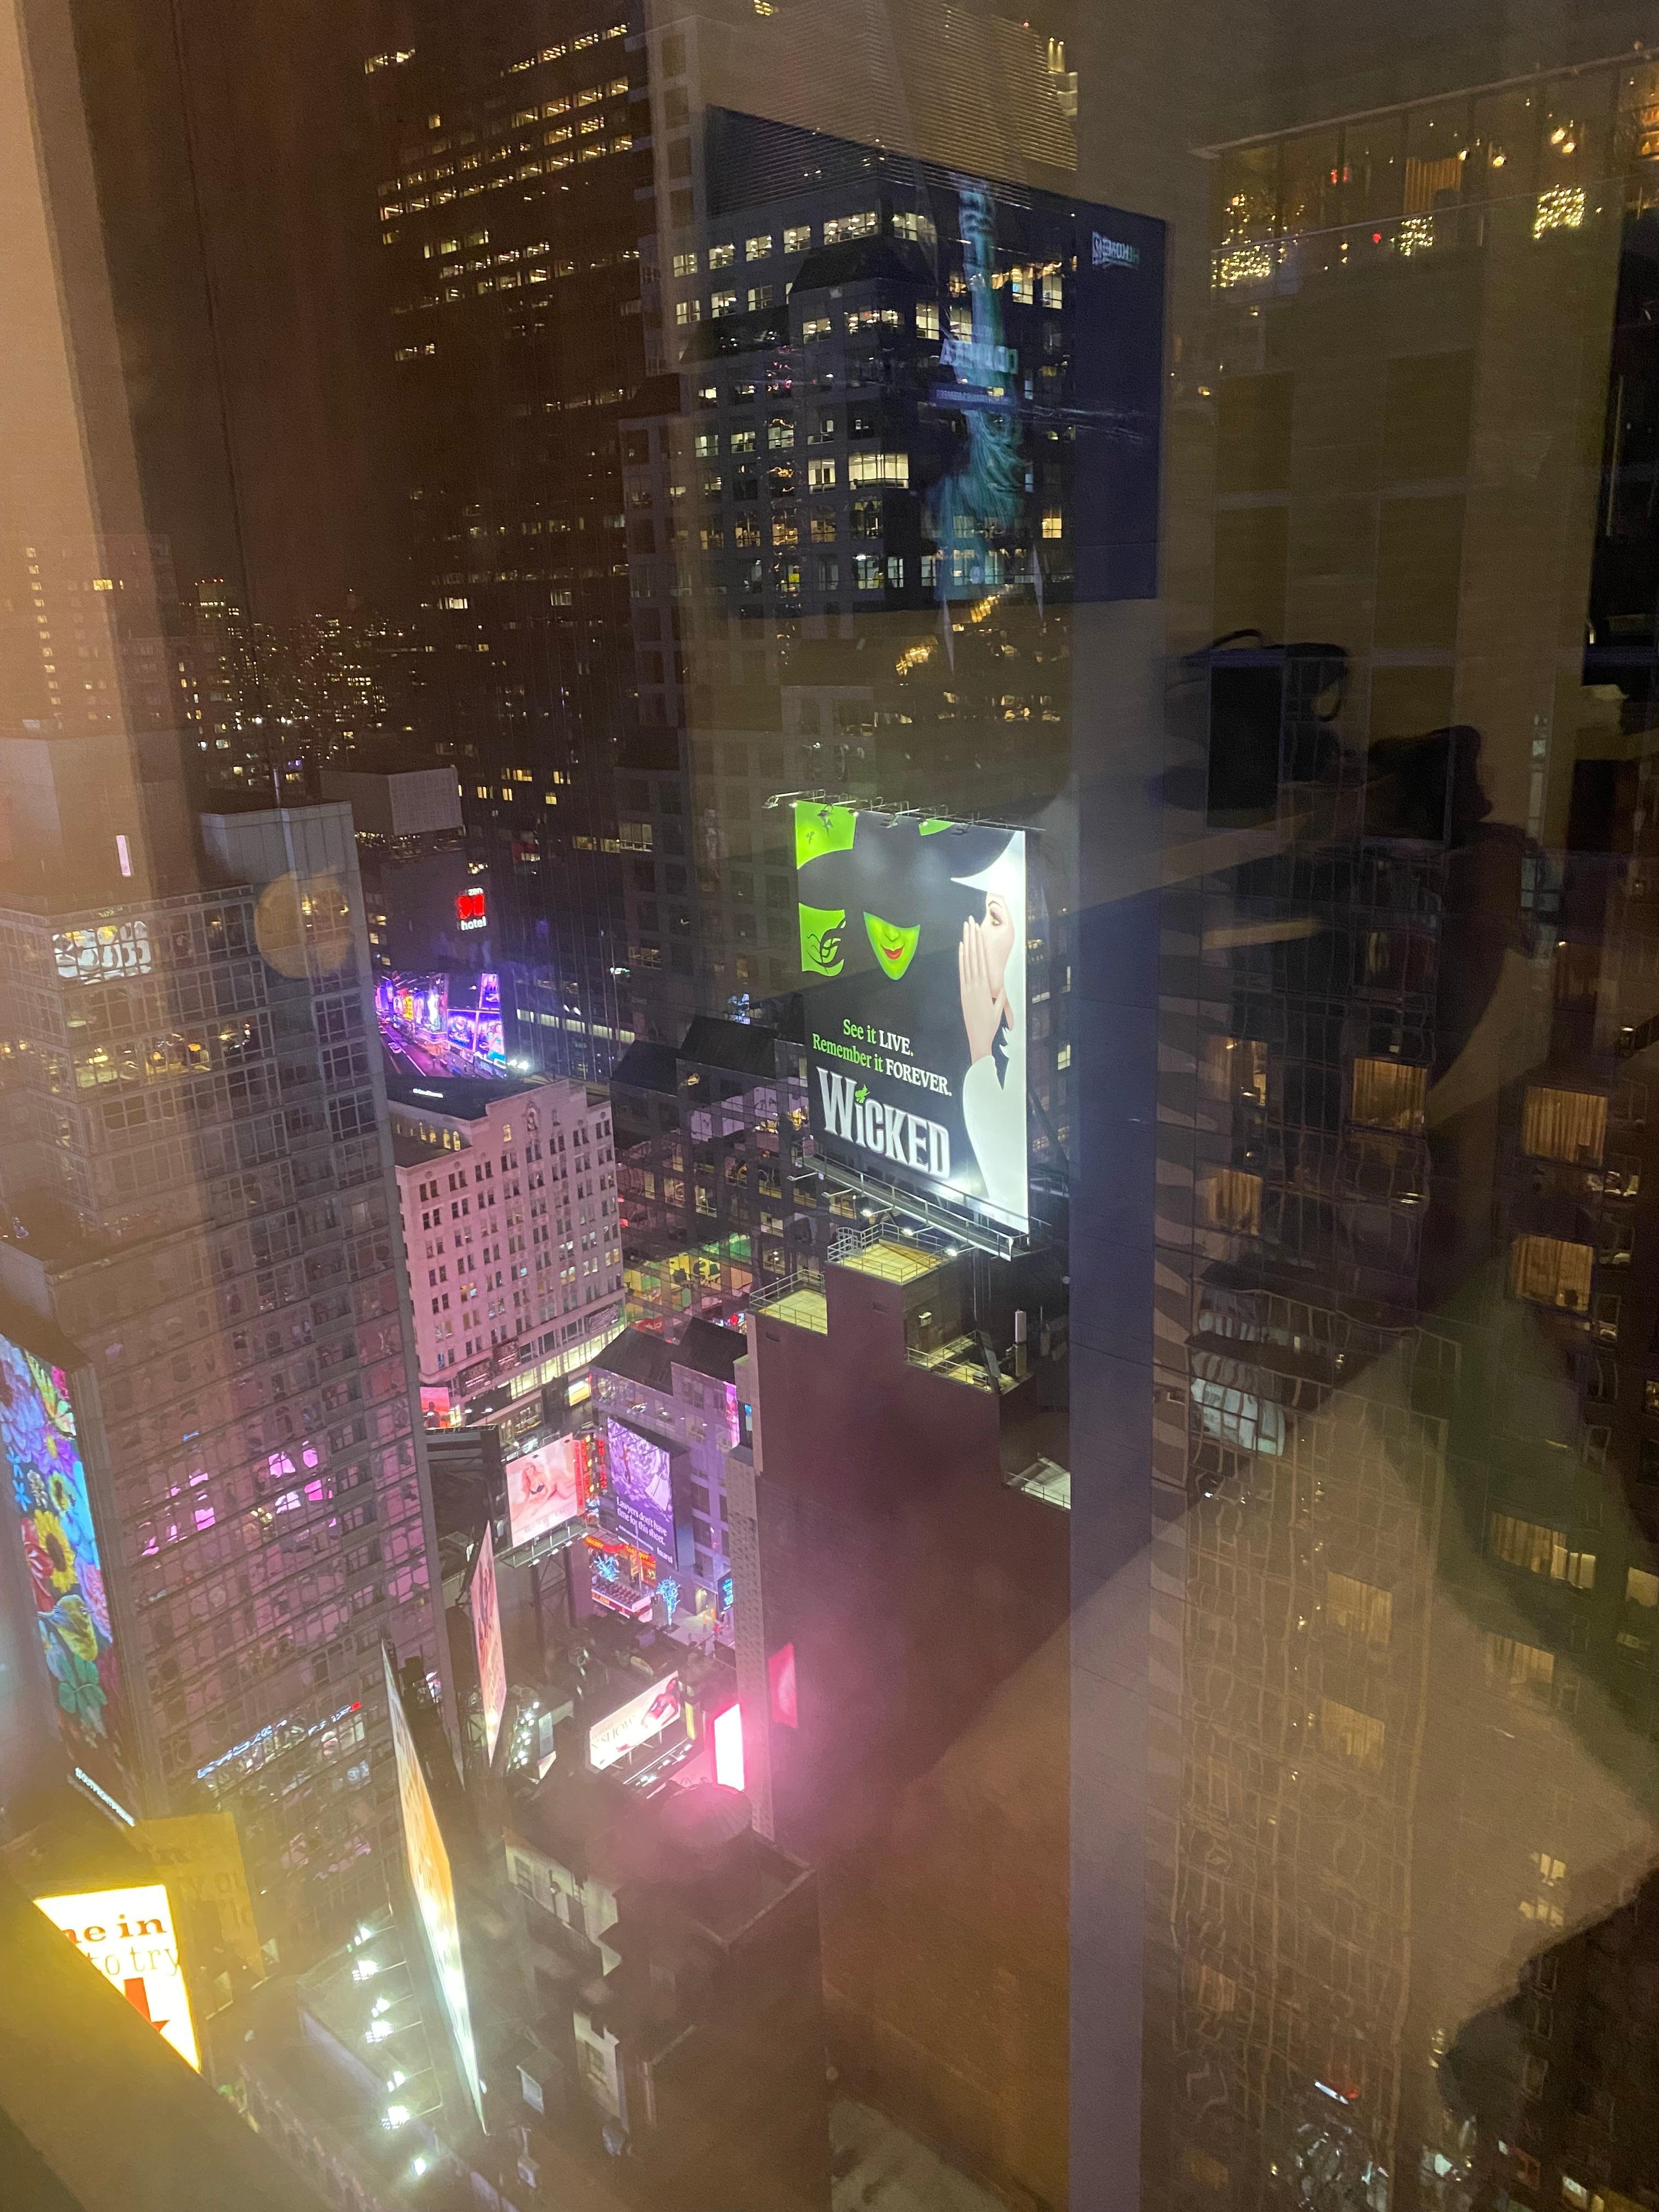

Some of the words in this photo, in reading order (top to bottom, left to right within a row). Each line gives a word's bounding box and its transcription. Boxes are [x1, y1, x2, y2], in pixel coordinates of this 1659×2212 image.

[461, 916, 487, 931] hotel
[843, 1018, 864, 1040] See
[867, 1025, 877, 1044] it
[879, 1030, 913, 1057] LIVE.
[812, 1033, 872, 1069] Remember
[874, 1053, 884, 1073] it
[885, 1058, 952, 1097] FOREVER.
[616, 1496, 639, 1518] Lawyers
[653, 1520, 668, 1537] have
[117, 1914, 167, 1938] in
[129, 1946, 179, 1976] try
